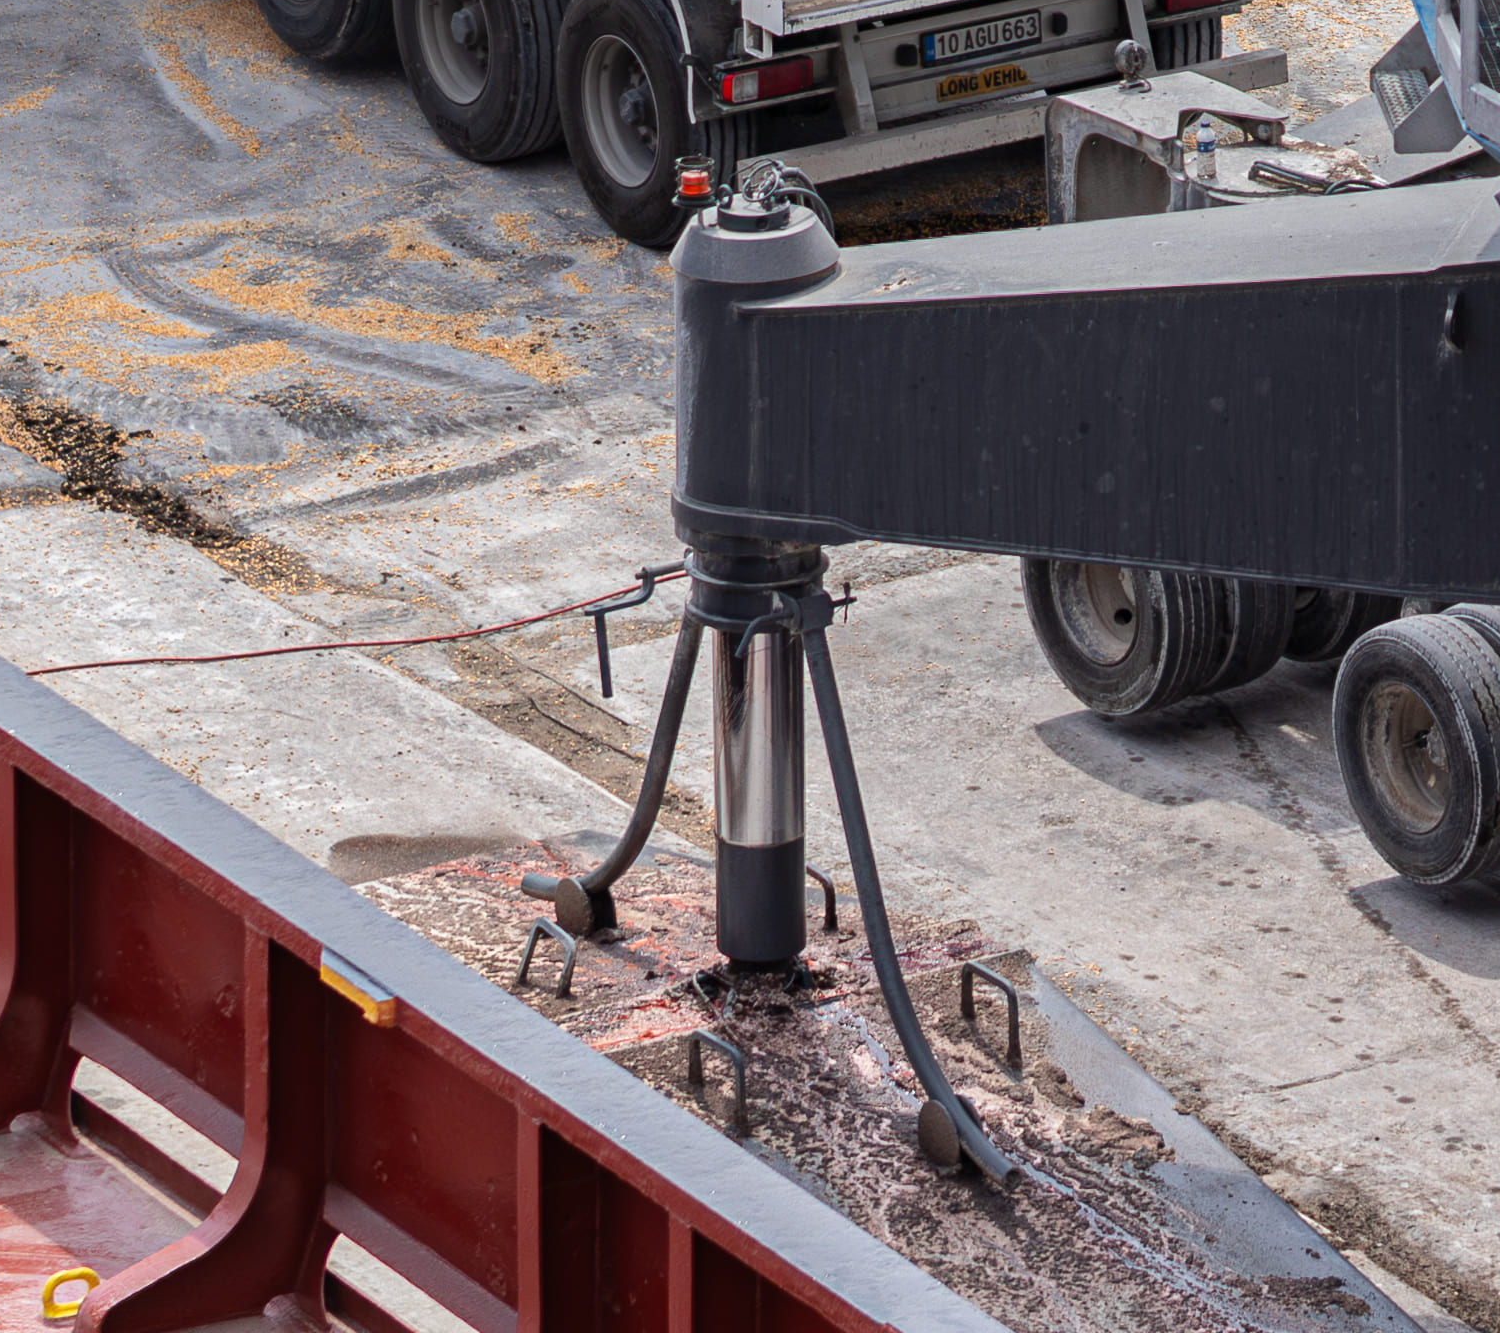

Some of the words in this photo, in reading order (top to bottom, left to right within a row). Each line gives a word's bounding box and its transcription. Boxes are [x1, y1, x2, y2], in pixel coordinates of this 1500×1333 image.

[938, 33, 959, 55] 10
[964, 23, 999, 51] AGU
[1002, 16, 1037, 42] 663
[940, 76, 978, 97] LONG
